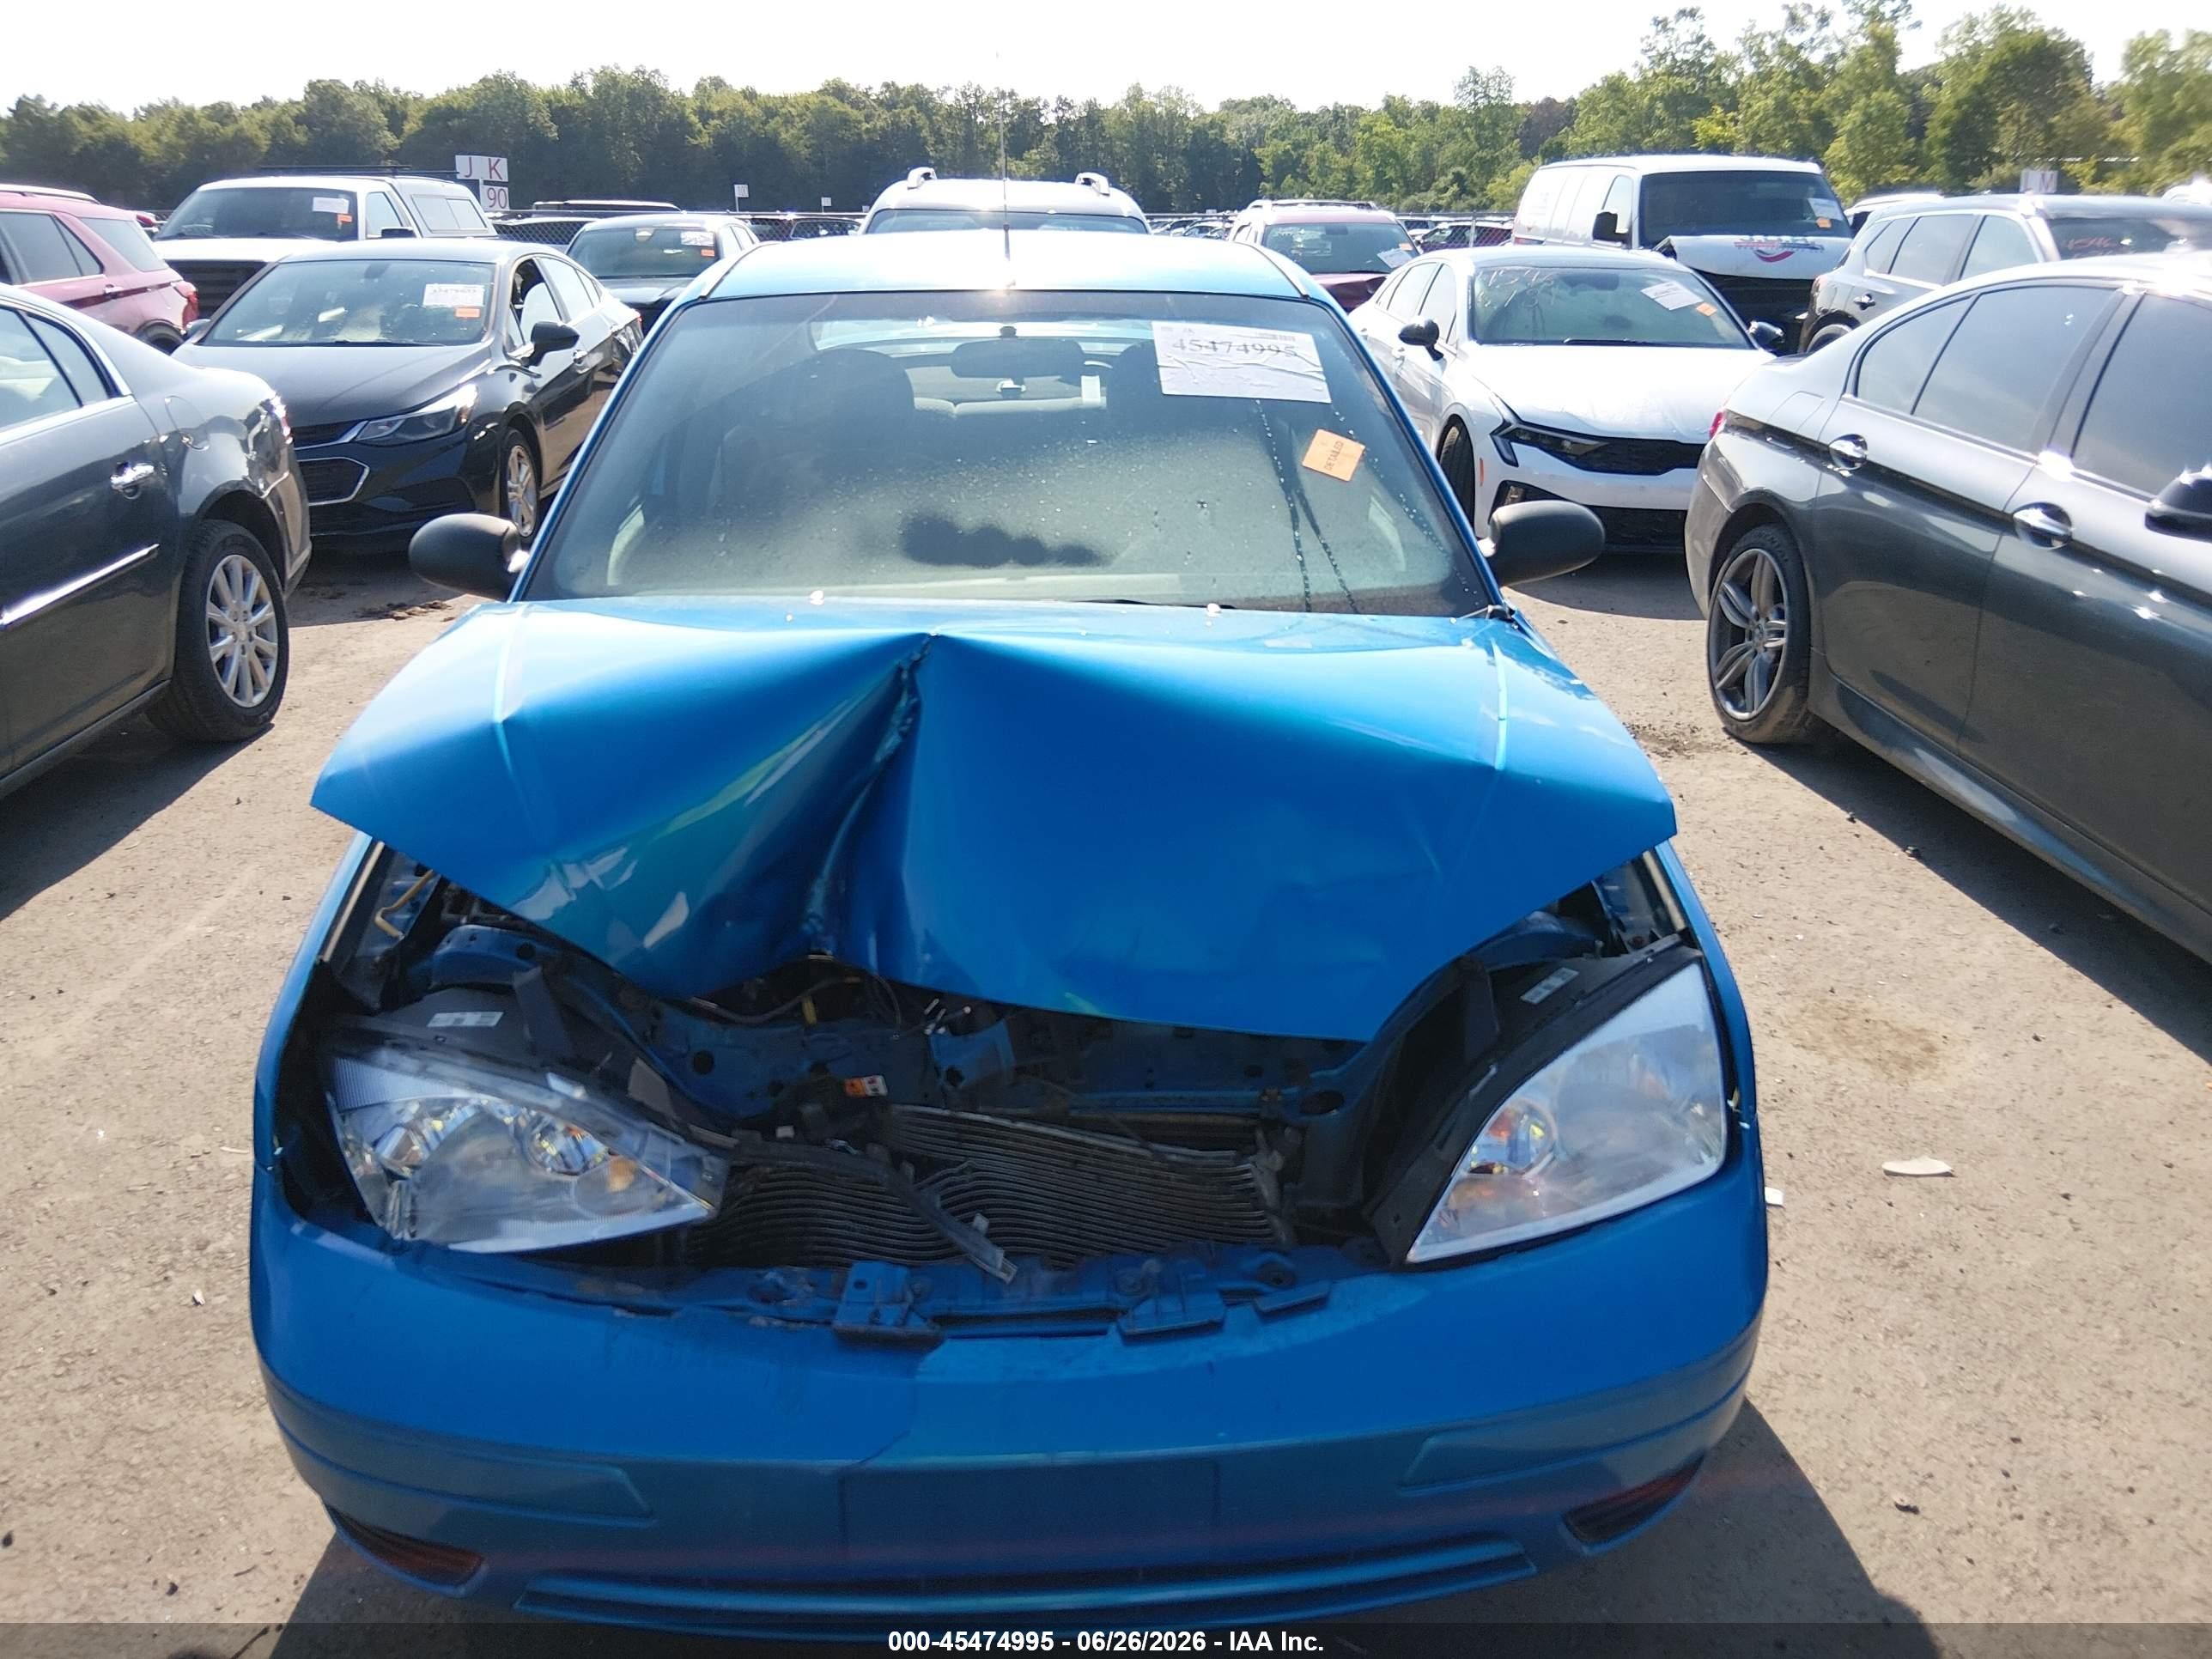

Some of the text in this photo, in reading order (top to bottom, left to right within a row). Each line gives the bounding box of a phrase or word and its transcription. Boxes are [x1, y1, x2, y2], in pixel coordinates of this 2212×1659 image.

[465, 156, 503, 180] J K
[487, 187, 508, 210] 90
[1172, 338, 1298, 359] 45474995
